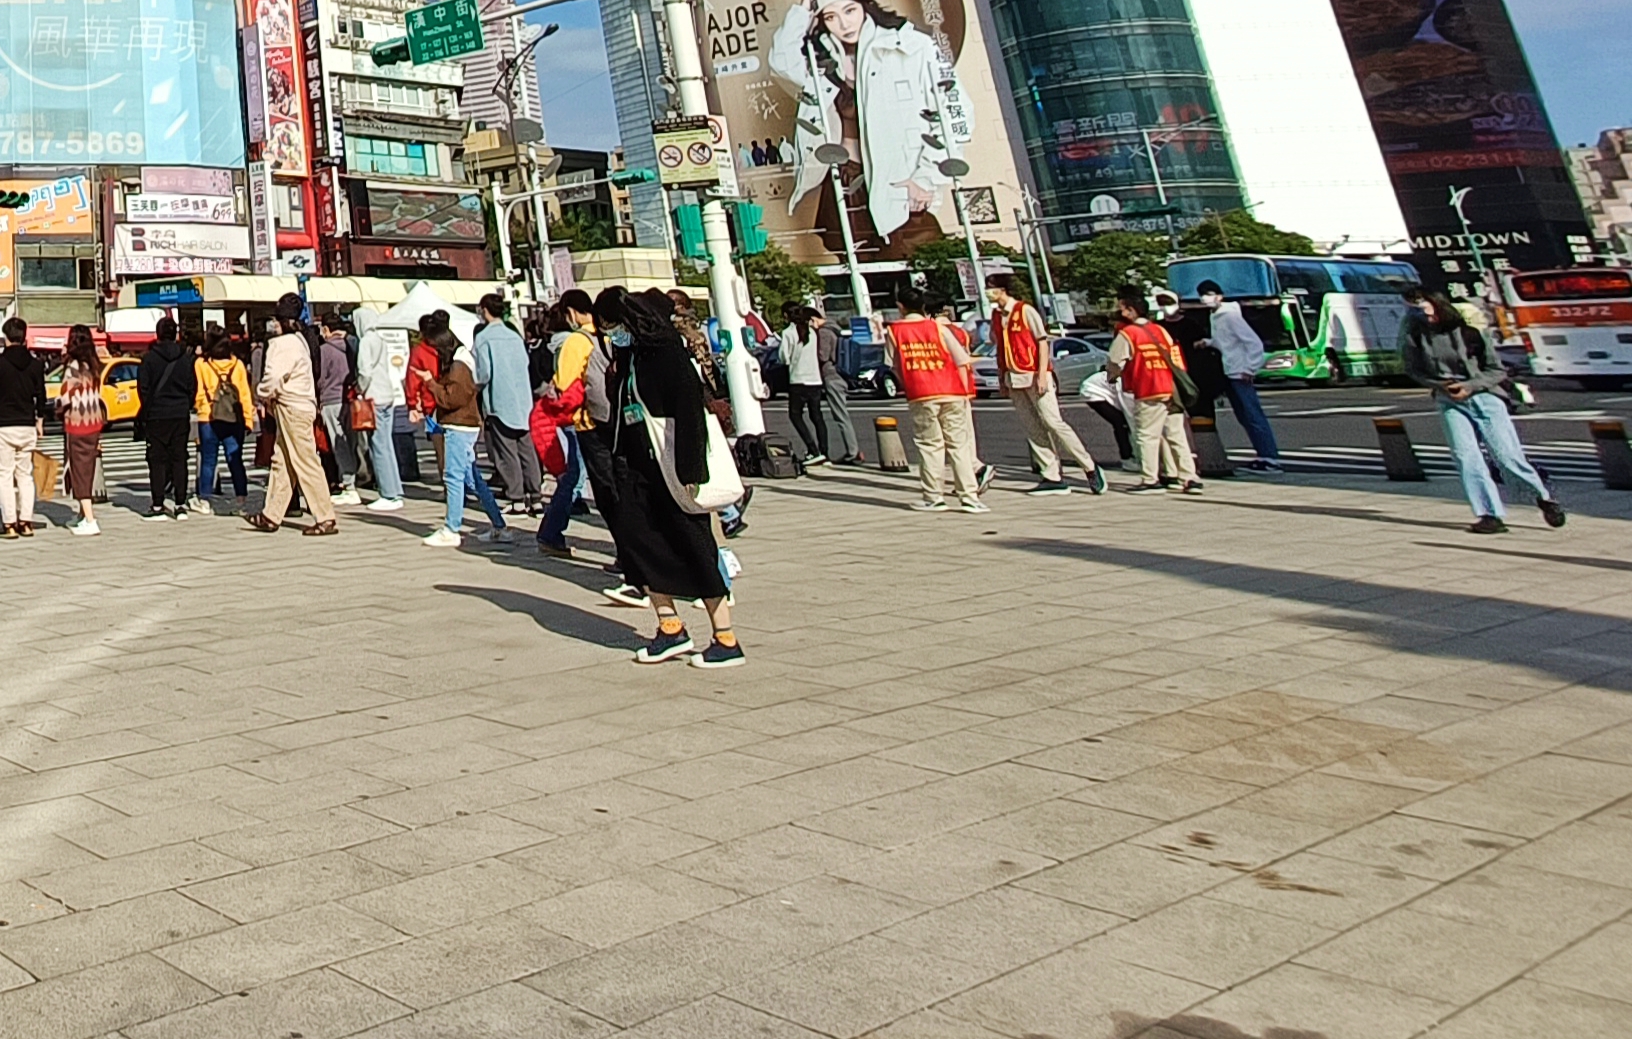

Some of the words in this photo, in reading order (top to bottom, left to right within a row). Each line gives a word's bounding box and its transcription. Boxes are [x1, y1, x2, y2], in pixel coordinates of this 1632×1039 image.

[24, 14, 212, 64] 風華再現
[1409, 231, 1531, 249] MIDTOWN
